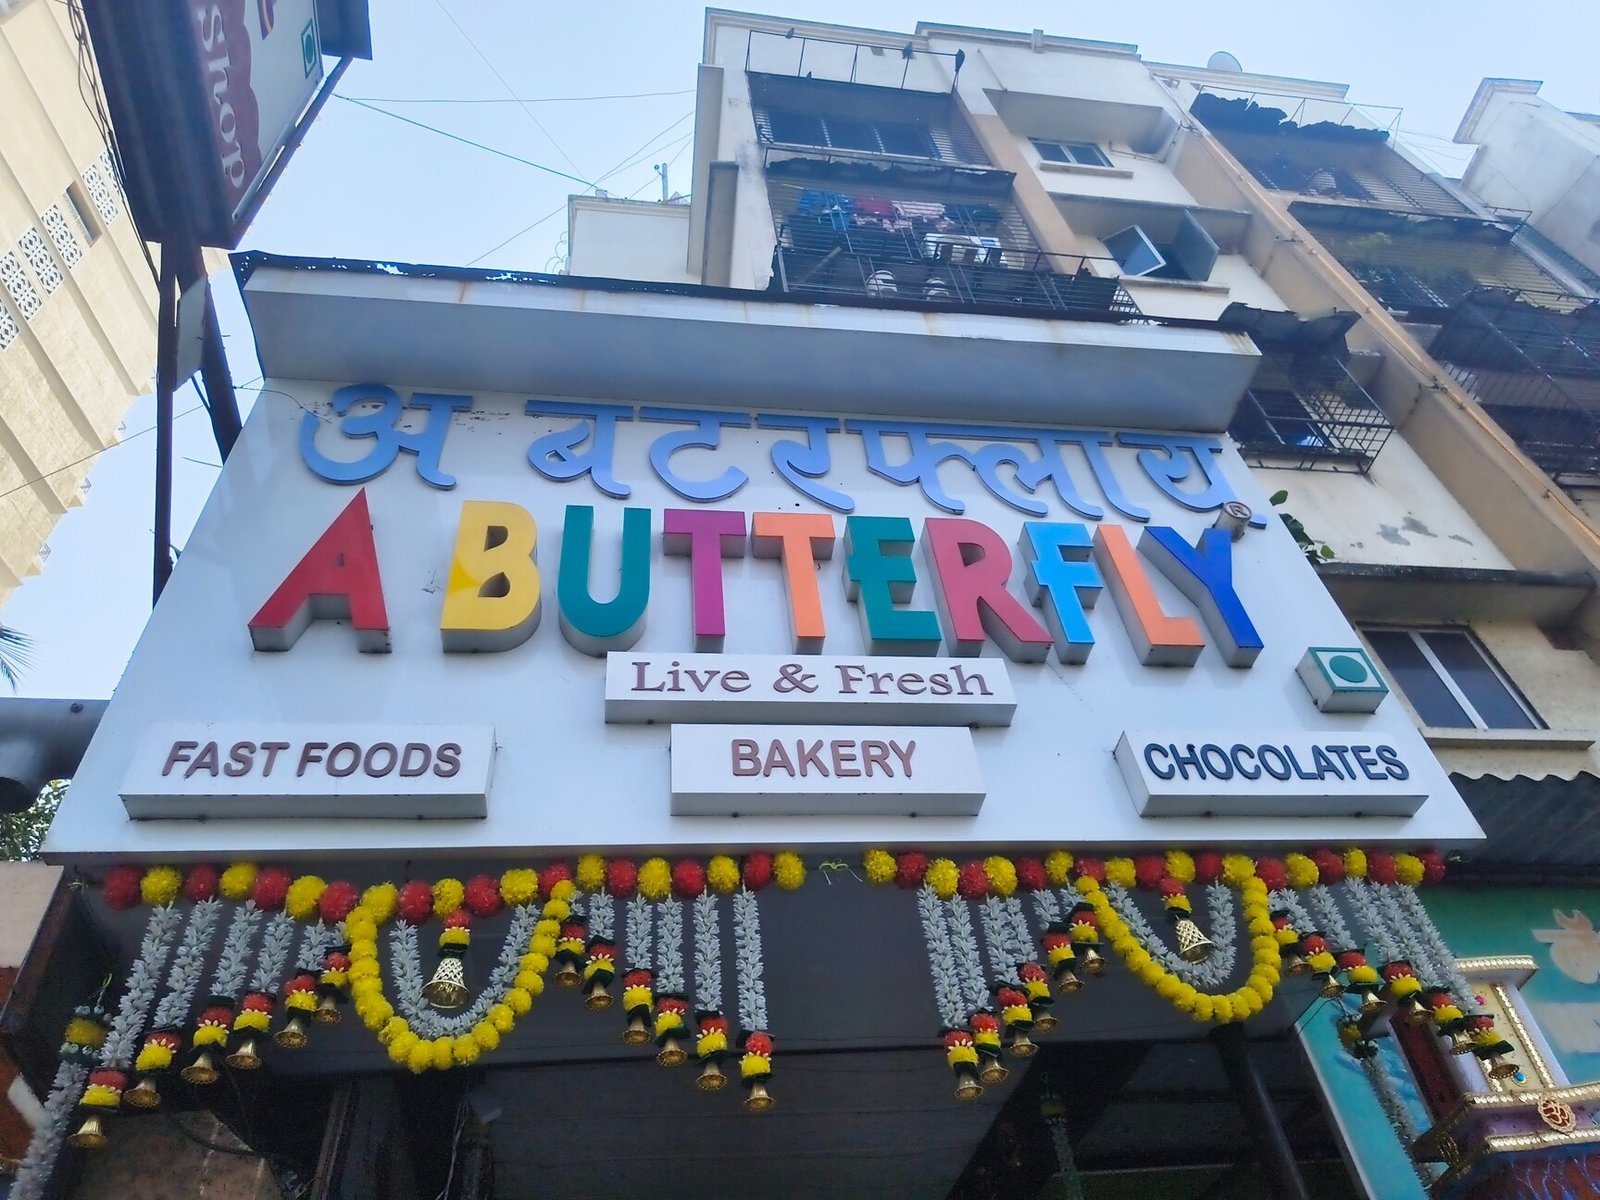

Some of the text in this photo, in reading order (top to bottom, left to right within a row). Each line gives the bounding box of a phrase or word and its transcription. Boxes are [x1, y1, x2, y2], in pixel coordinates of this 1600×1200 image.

[198, 5, 245, 188] Shop
[300, 383, 1267, 530] अ बटरफ्लाय
[249, 487, 392, 654] A
[440, 500, 1265, 668] BUTTERFLY
[631, 661, 994, 696] Live & Fresh
[162, 741, 461, 778] FAST FOODS
[732, 739, 916, 778] BAKERY
[1144, 743, 1410, 781] CHOCOLATES
